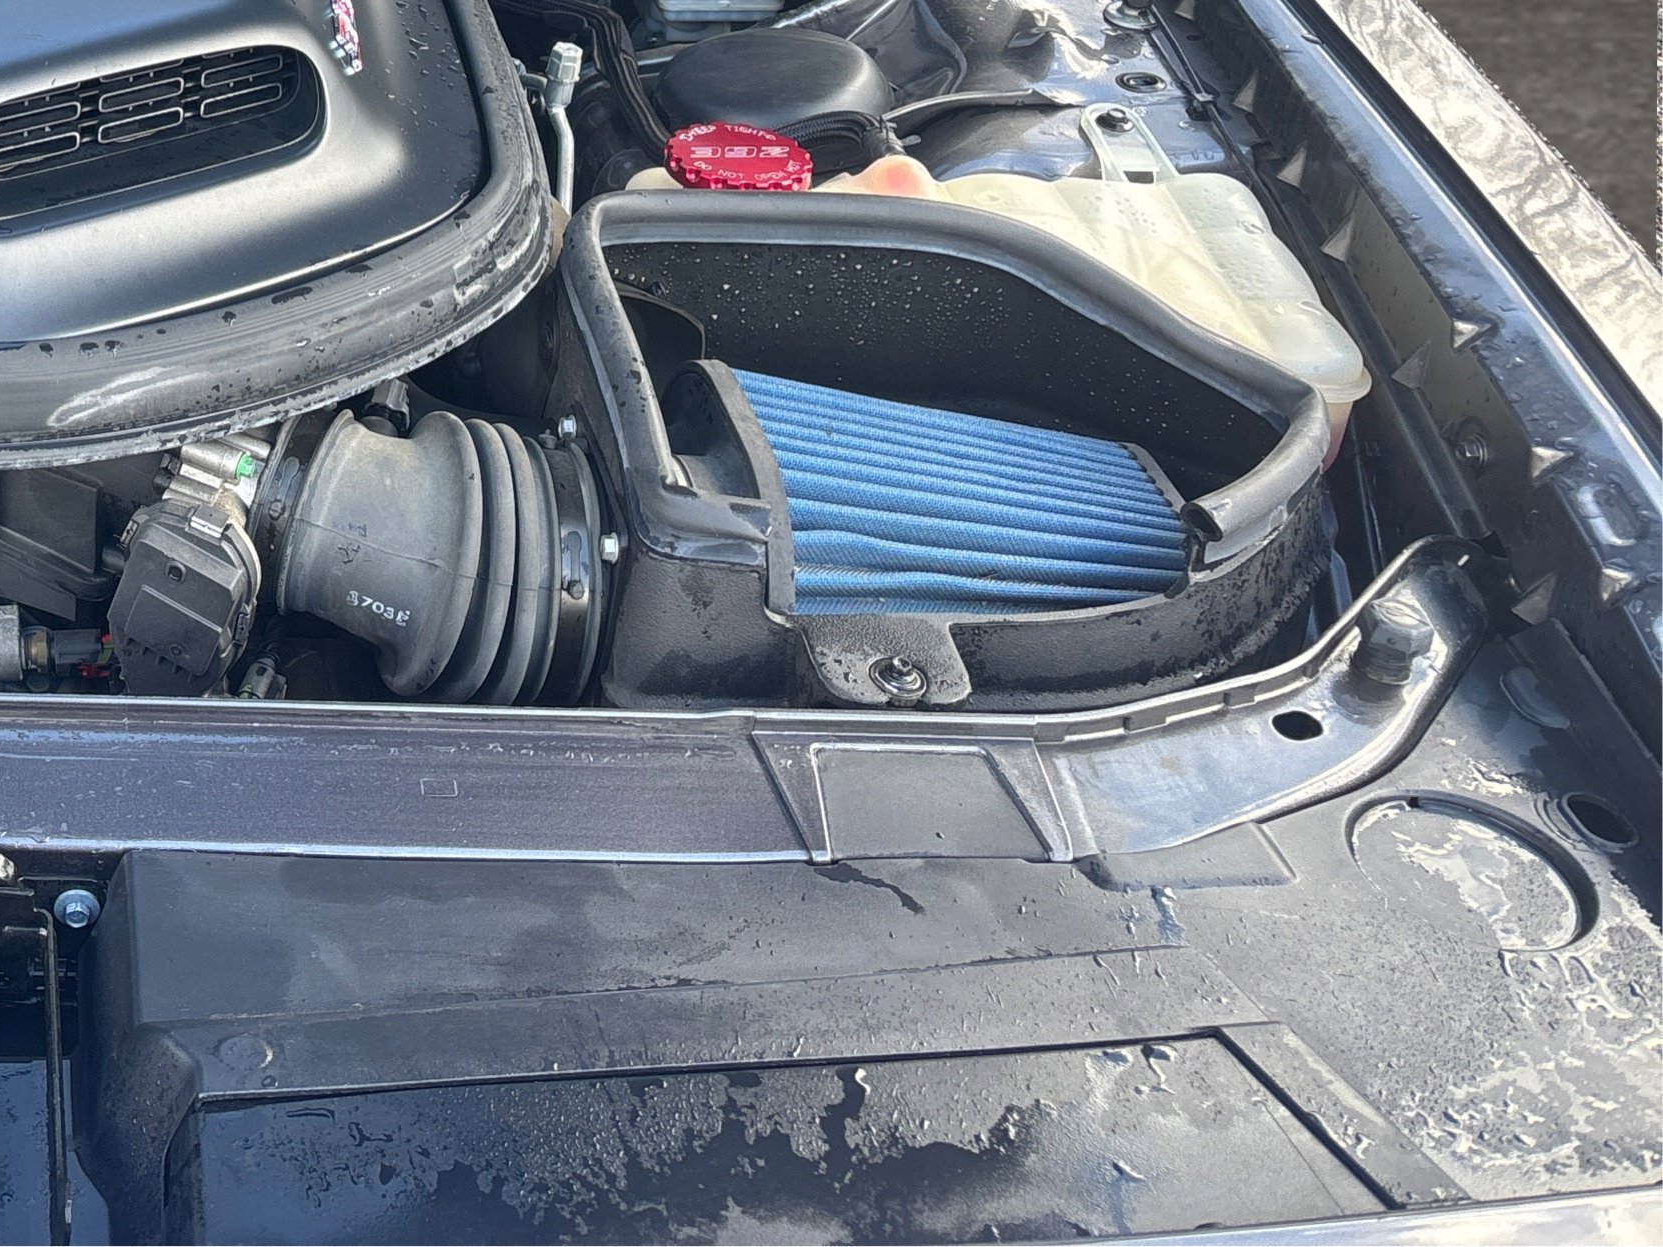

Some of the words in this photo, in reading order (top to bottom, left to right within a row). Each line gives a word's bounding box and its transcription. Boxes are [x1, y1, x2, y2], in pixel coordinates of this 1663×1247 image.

[690, 146, 791, 159] 392
[693, 160, 713, 171] DO
[717, 169, 745, 180] NOT
[754, 170, 787, 181] OPEN
